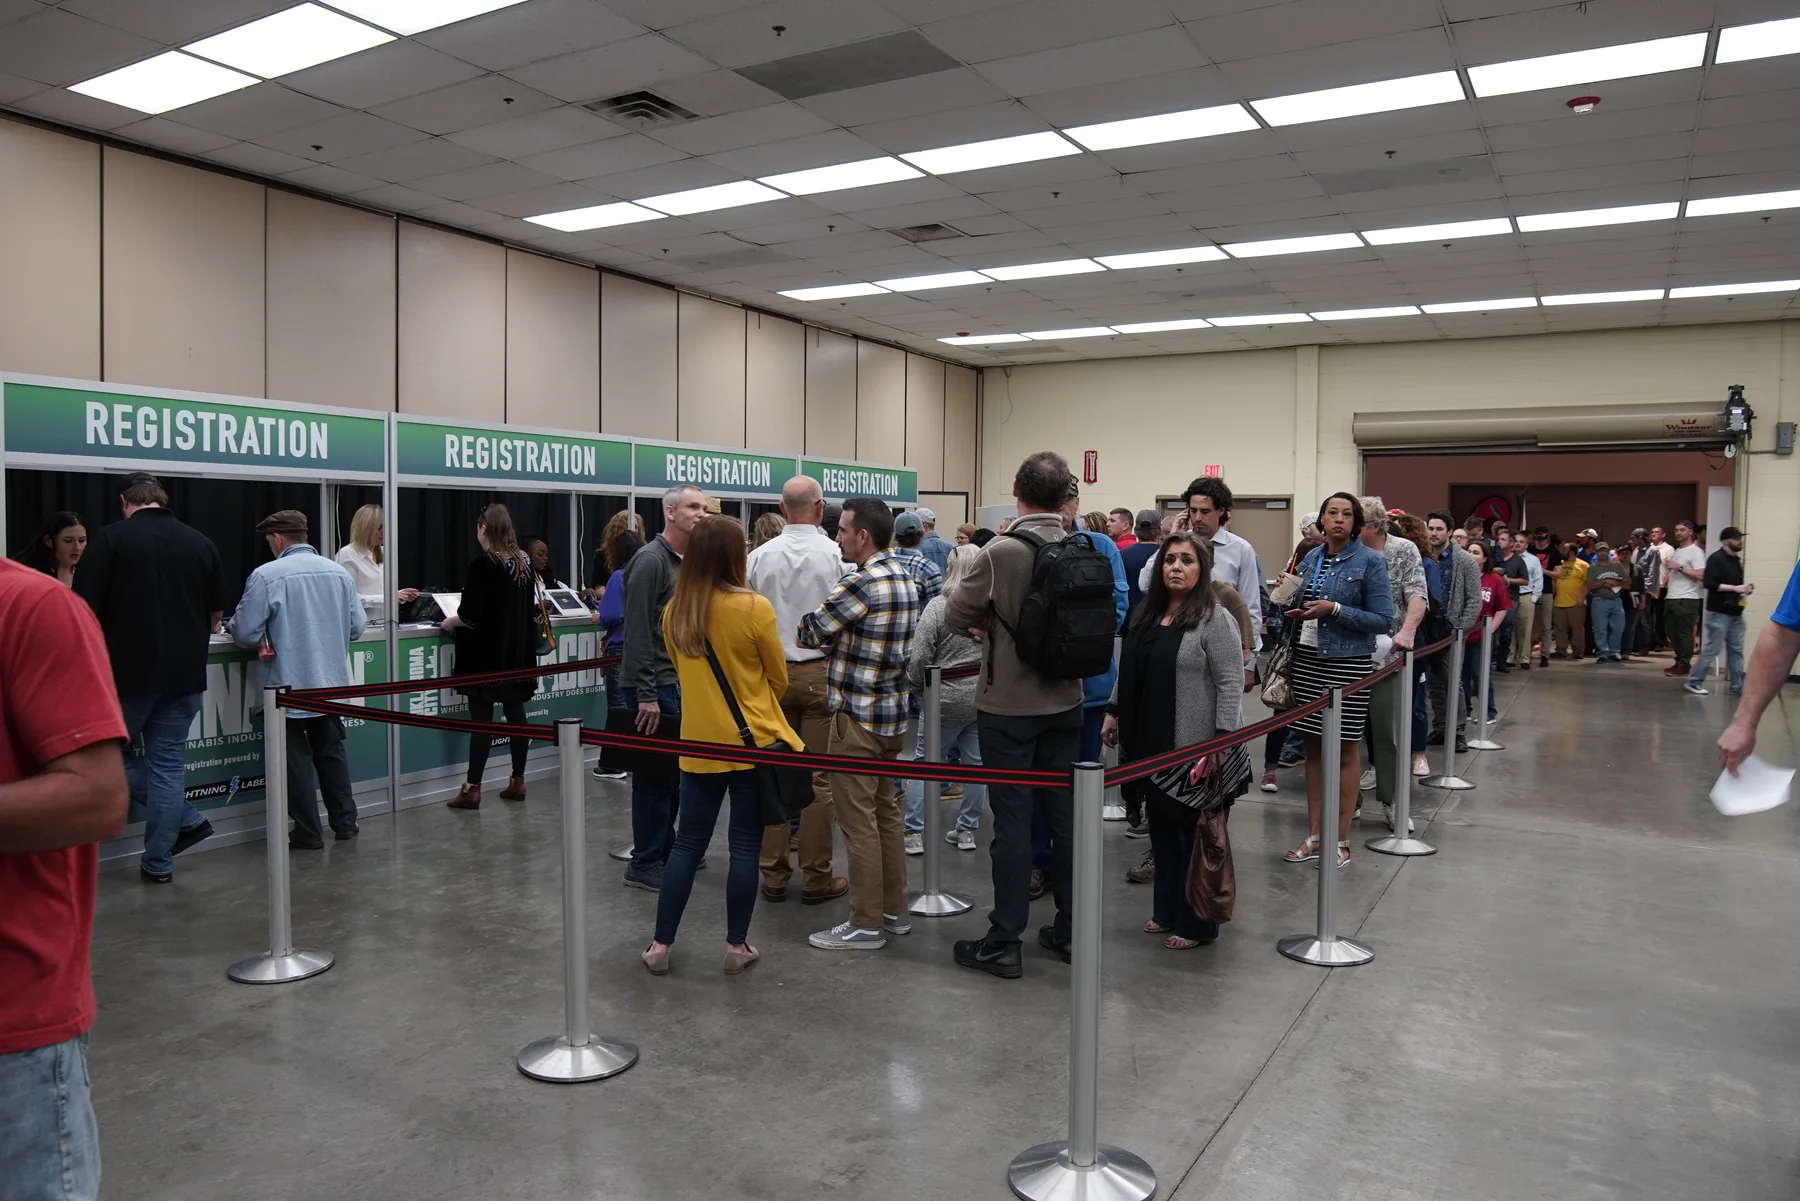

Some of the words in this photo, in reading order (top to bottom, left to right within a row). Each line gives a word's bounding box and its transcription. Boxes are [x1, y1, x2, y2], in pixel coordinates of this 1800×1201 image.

[86, 401, 328, 459] REGISTRATION
[445, 434, 596, 476] REGISTRATION
[666, 454, 771, 487] REGISTRATION
[822, 468, 899, 496] REGISTRATION
[1204, 464, 1220, 477] EXIT
[441, 704, 469, 714] WHERE
[531, 691, 564, 701] NDUSTRY
[566, 688, 584, 697] DOES
[585, 685, 606, 694] BUSIN
[543, 708, 549, 716] by
[186, 737, 224, 750] NABIS
[227, 731, 265, 744] INDUS
[184, 757, 222, 771] registration
[224, 753, 251, 766] powered
[252, 752, 260, 760] by
[185, 785, 227, 799] HTNING
[241, 778, 266, 789] LABE
